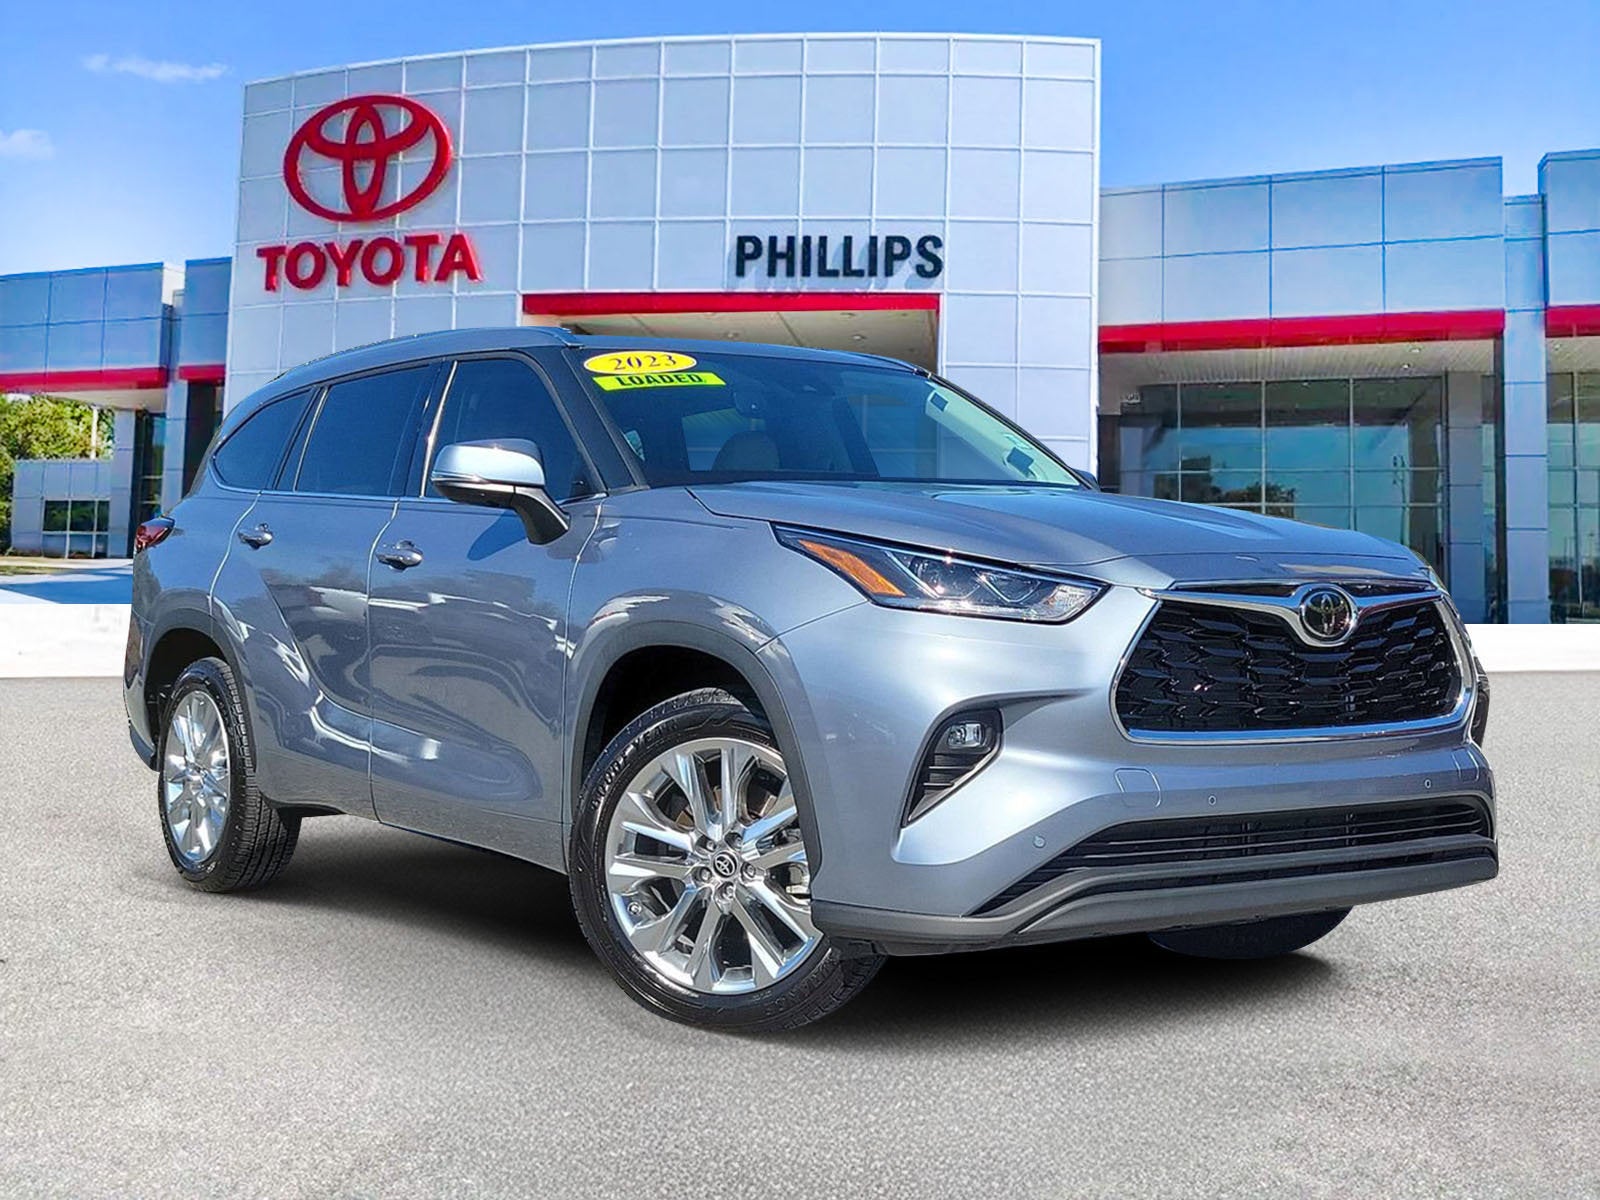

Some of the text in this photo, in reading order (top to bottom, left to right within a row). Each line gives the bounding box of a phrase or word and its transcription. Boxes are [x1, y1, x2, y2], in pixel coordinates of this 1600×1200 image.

[257, 234, 482, 292] TOYOTA
[735, 235, 944, 278] PHILLIPS
[609, 354, 677, 371] 2023
[616, 374, 704, 387] LOADED
